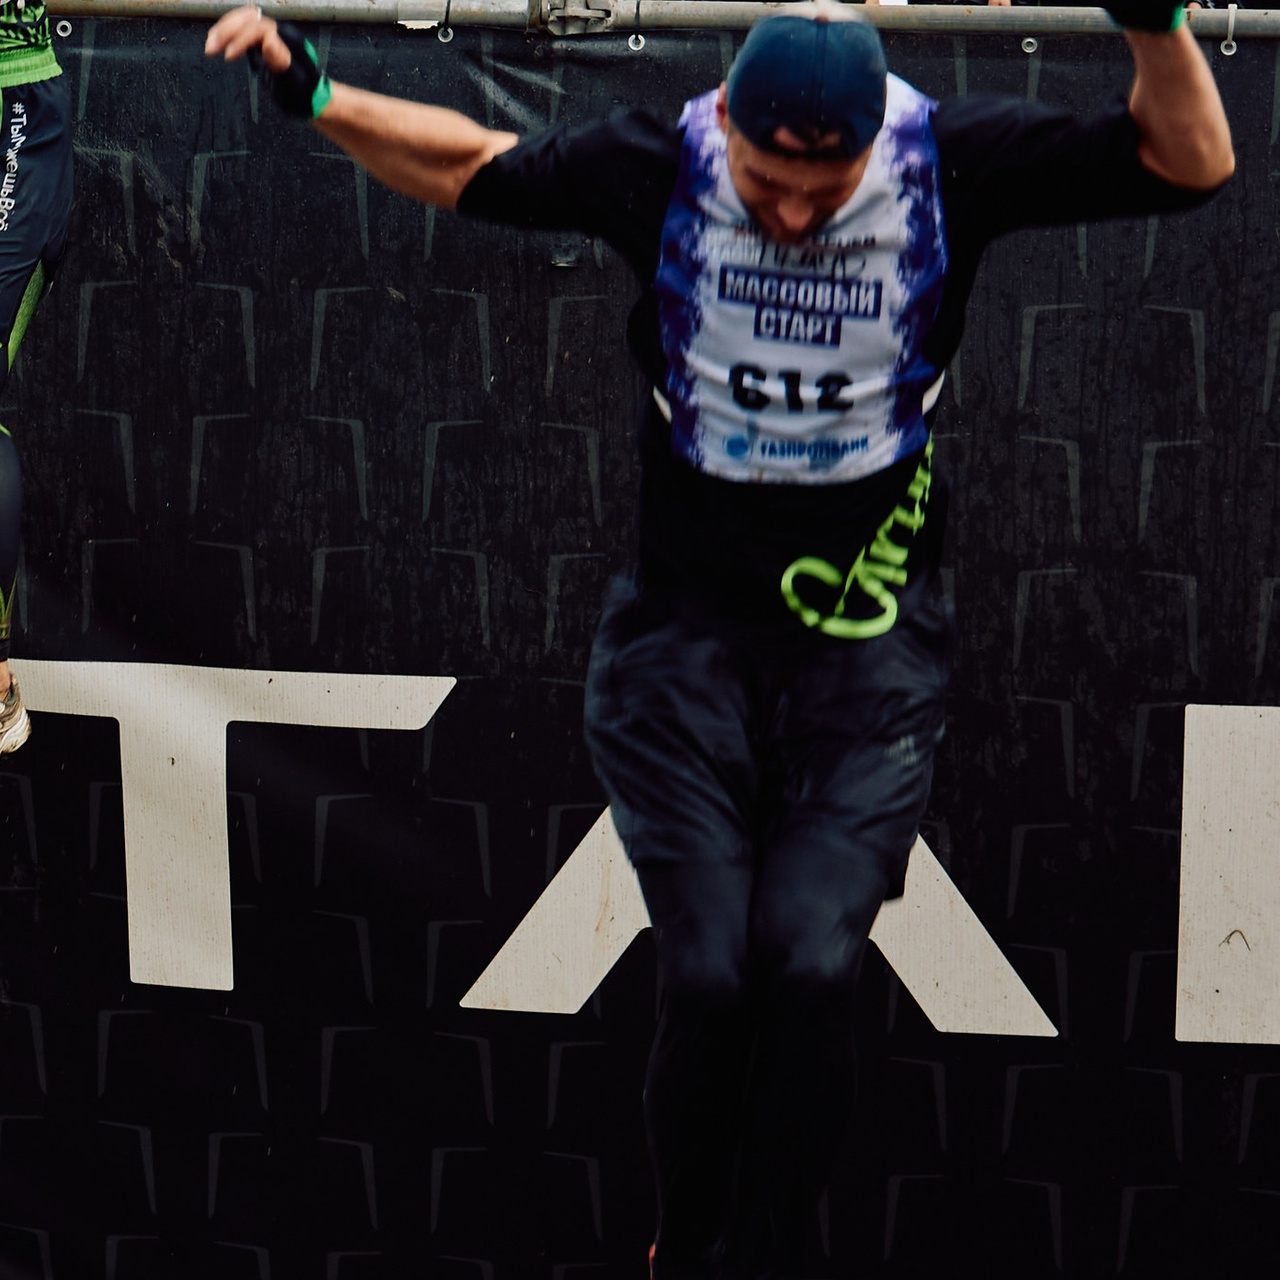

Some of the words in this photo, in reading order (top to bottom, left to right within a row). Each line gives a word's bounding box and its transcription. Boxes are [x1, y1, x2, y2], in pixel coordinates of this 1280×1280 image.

[725, 270, 877, 315] МАССОВЫЙ
[759, 307, 836, 344] СТАРТ
[728, 363, 854, 413] 612
